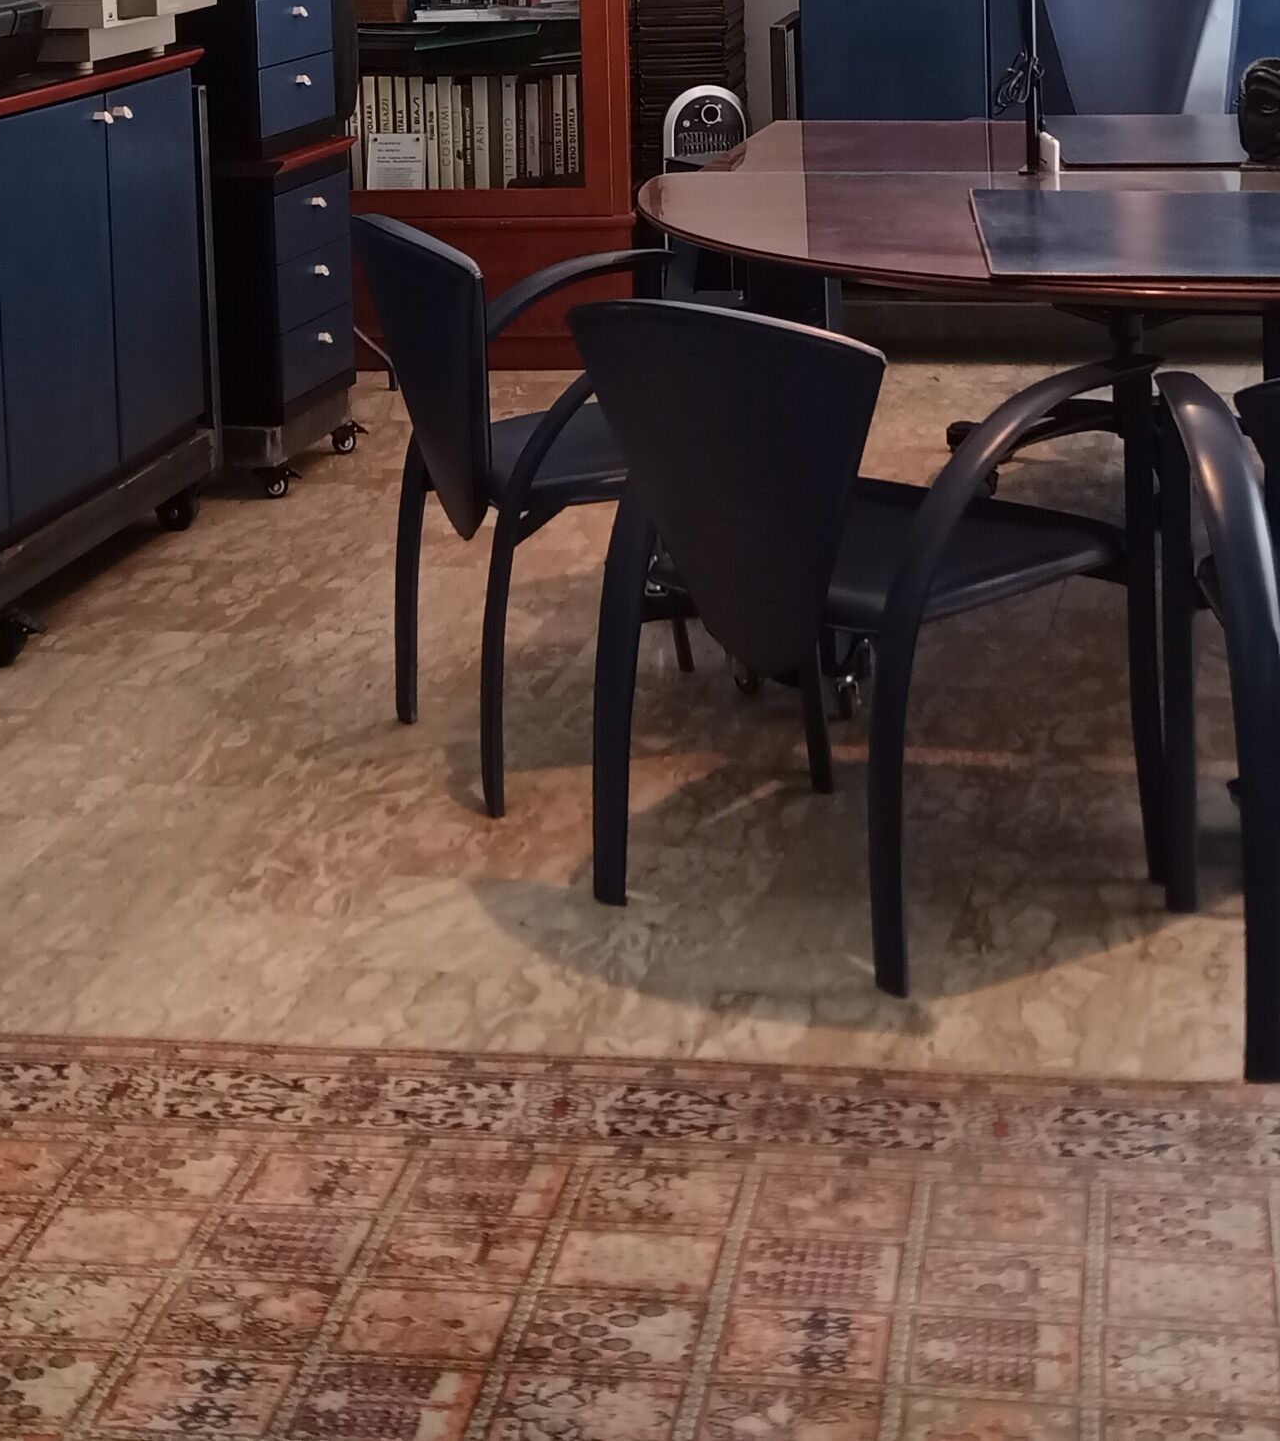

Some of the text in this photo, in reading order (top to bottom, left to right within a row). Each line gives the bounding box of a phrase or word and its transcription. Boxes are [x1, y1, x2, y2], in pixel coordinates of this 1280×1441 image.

[441, 106, 451, 167] COSTUMI
[475, 120, 485, 152] PANI
[504, 118, 514, 177] GIOIELLI
